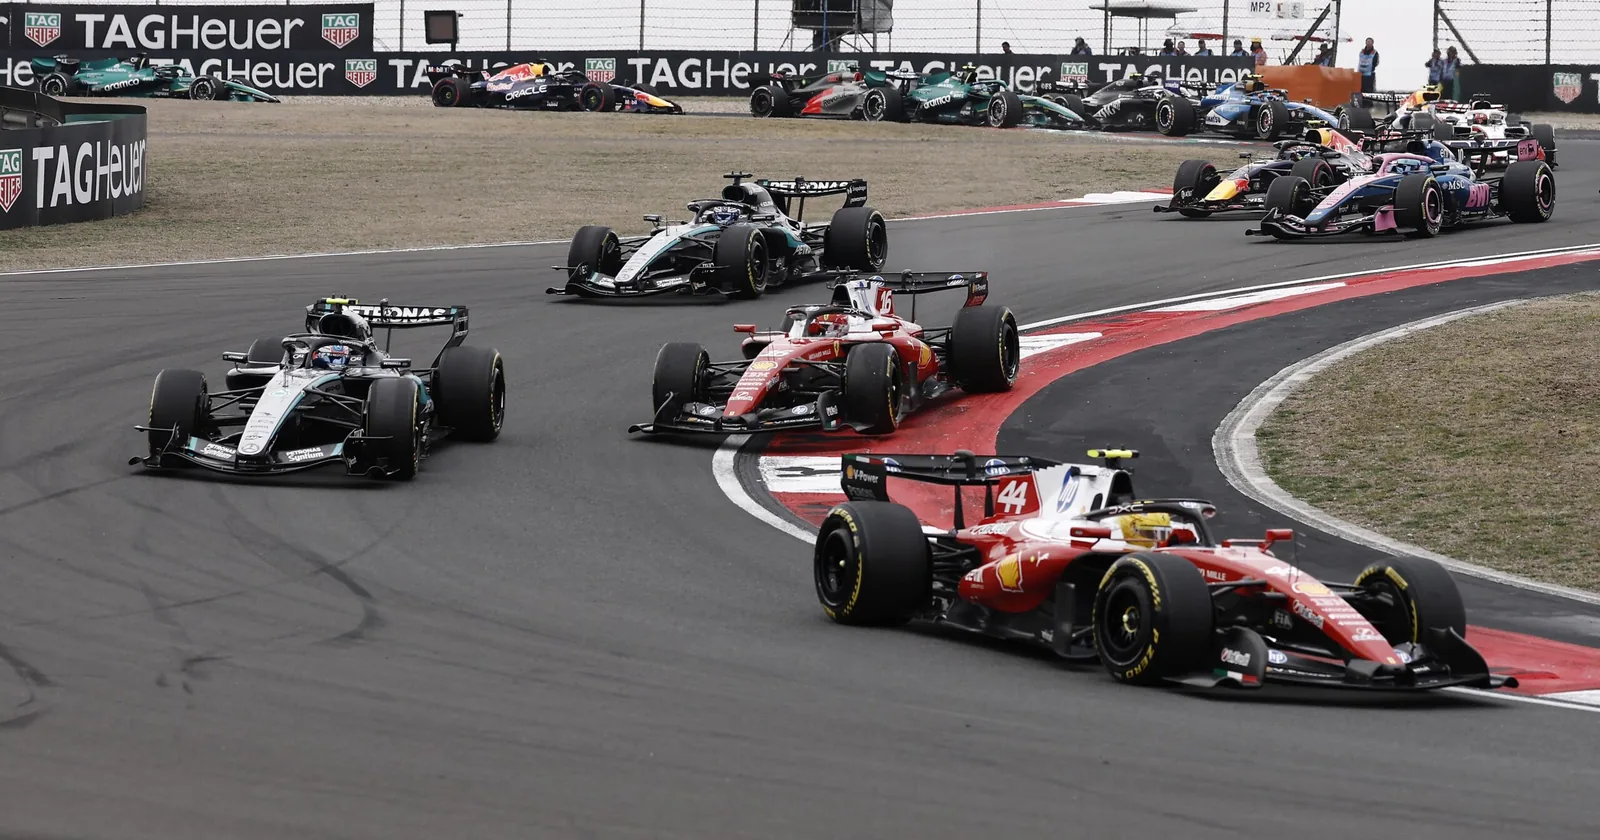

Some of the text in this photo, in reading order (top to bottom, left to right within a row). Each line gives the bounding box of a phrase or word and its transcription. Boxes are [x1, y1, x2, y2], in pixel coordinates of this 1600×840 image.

[1250, 2, 1271, 12] MP2
[28, 15, 57, 26] TAG
[325, 15, 356, 27] TAG
[27, 28, 59, 44] HEUER
[323, 29, 358, 47] HEUER
[347, 60, 375, 71] TAG
[588, 60, 613, 70] TAG
[1064, 64, 1086, 75] TAG
[104, 78, 140, 92] aramco
[346, 72, 375, 86] HEUER
[504, 85, 548, 101] ORACLE
[924, 95, 951, 109] aramco
[0, 153, 20, 173] AG
[1448, 181, 1466, 190] MSC
[880, 290, 892, 314] 16
[286, 447, 322, 456] PETRONAS
[287, 452, 324, 462] Syntium
[852, 468, 879, 484] V-Power
[997, 480, 1029, 515] 44
[1206, 570, 1226, 582] MILLE
